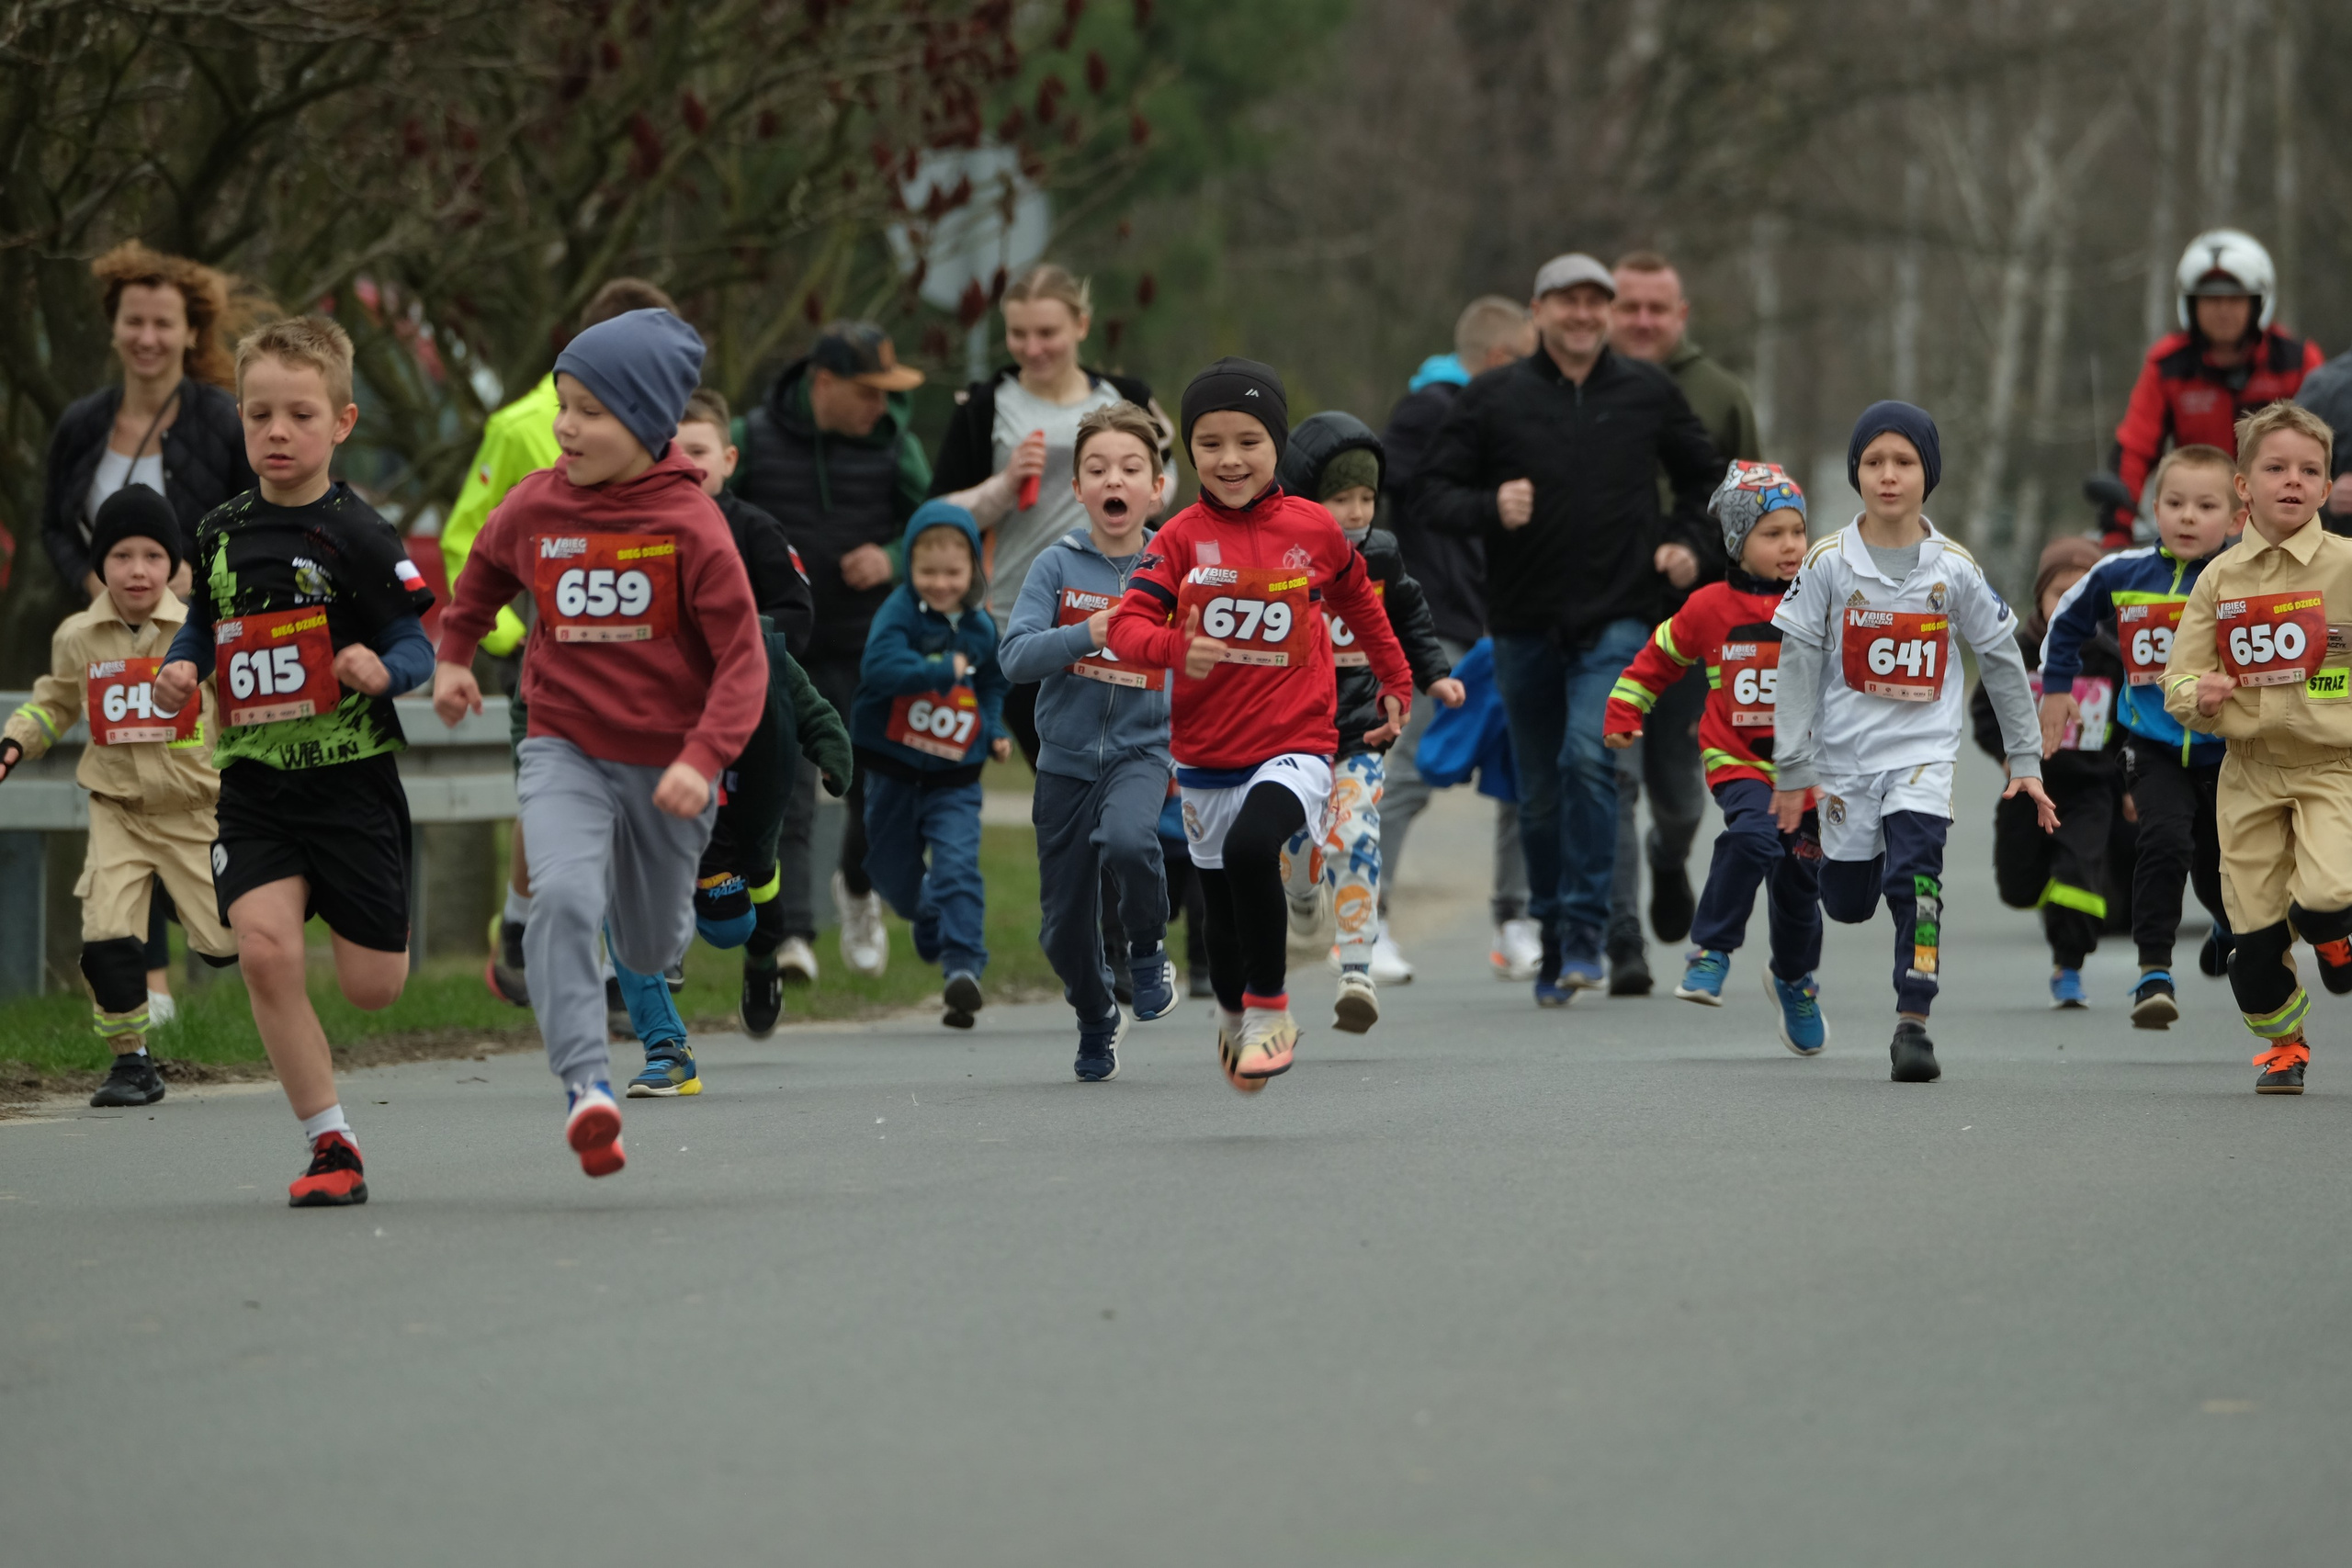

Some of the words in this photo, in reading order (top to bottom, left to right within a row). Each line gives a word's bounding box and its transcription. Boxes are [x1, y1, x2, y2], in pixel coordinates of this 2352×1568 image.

[560, 537, 586, 548] BIEG
[617, 547, 640, 560] BIEG
[1187, 567, 1210, 584] IV
[1209, 568, 1238, 579] BIEG
[556, 568, 651, 616] 659
[1269, 581, 1287, 592] BIEG
[1288, 577, 1307, 589] DZIECI
[1083, 594, 1109, 605] BIEG
[2224, 601, 2246, 611] BIEG
[2273, 603, 2294, 615] BIEG
[2295, 598, 2321, 610] DZIECI
[1204, 597, 1292, 642] 679
[1849, 610, 1869, 626] IV
[1868, 612, 1894, 621] BIEG
[271, 623, 295, 638] BIEG
[1921, 622, 1936, 632] BIEG
[1735, 643, 1757, 653] BIEG
[2132, 627, 2176, 666] 63
[2230, 622, 2306, 666] 650
[1869, 637, 1937, 678] 641
[230, 645, 306, 700] 615
[1734, 668, 1778, 705] 65
[103, 682, 180, 722] 64
[908, 699, 976, 744] 607
[708, 879, 745, 900] RACE
